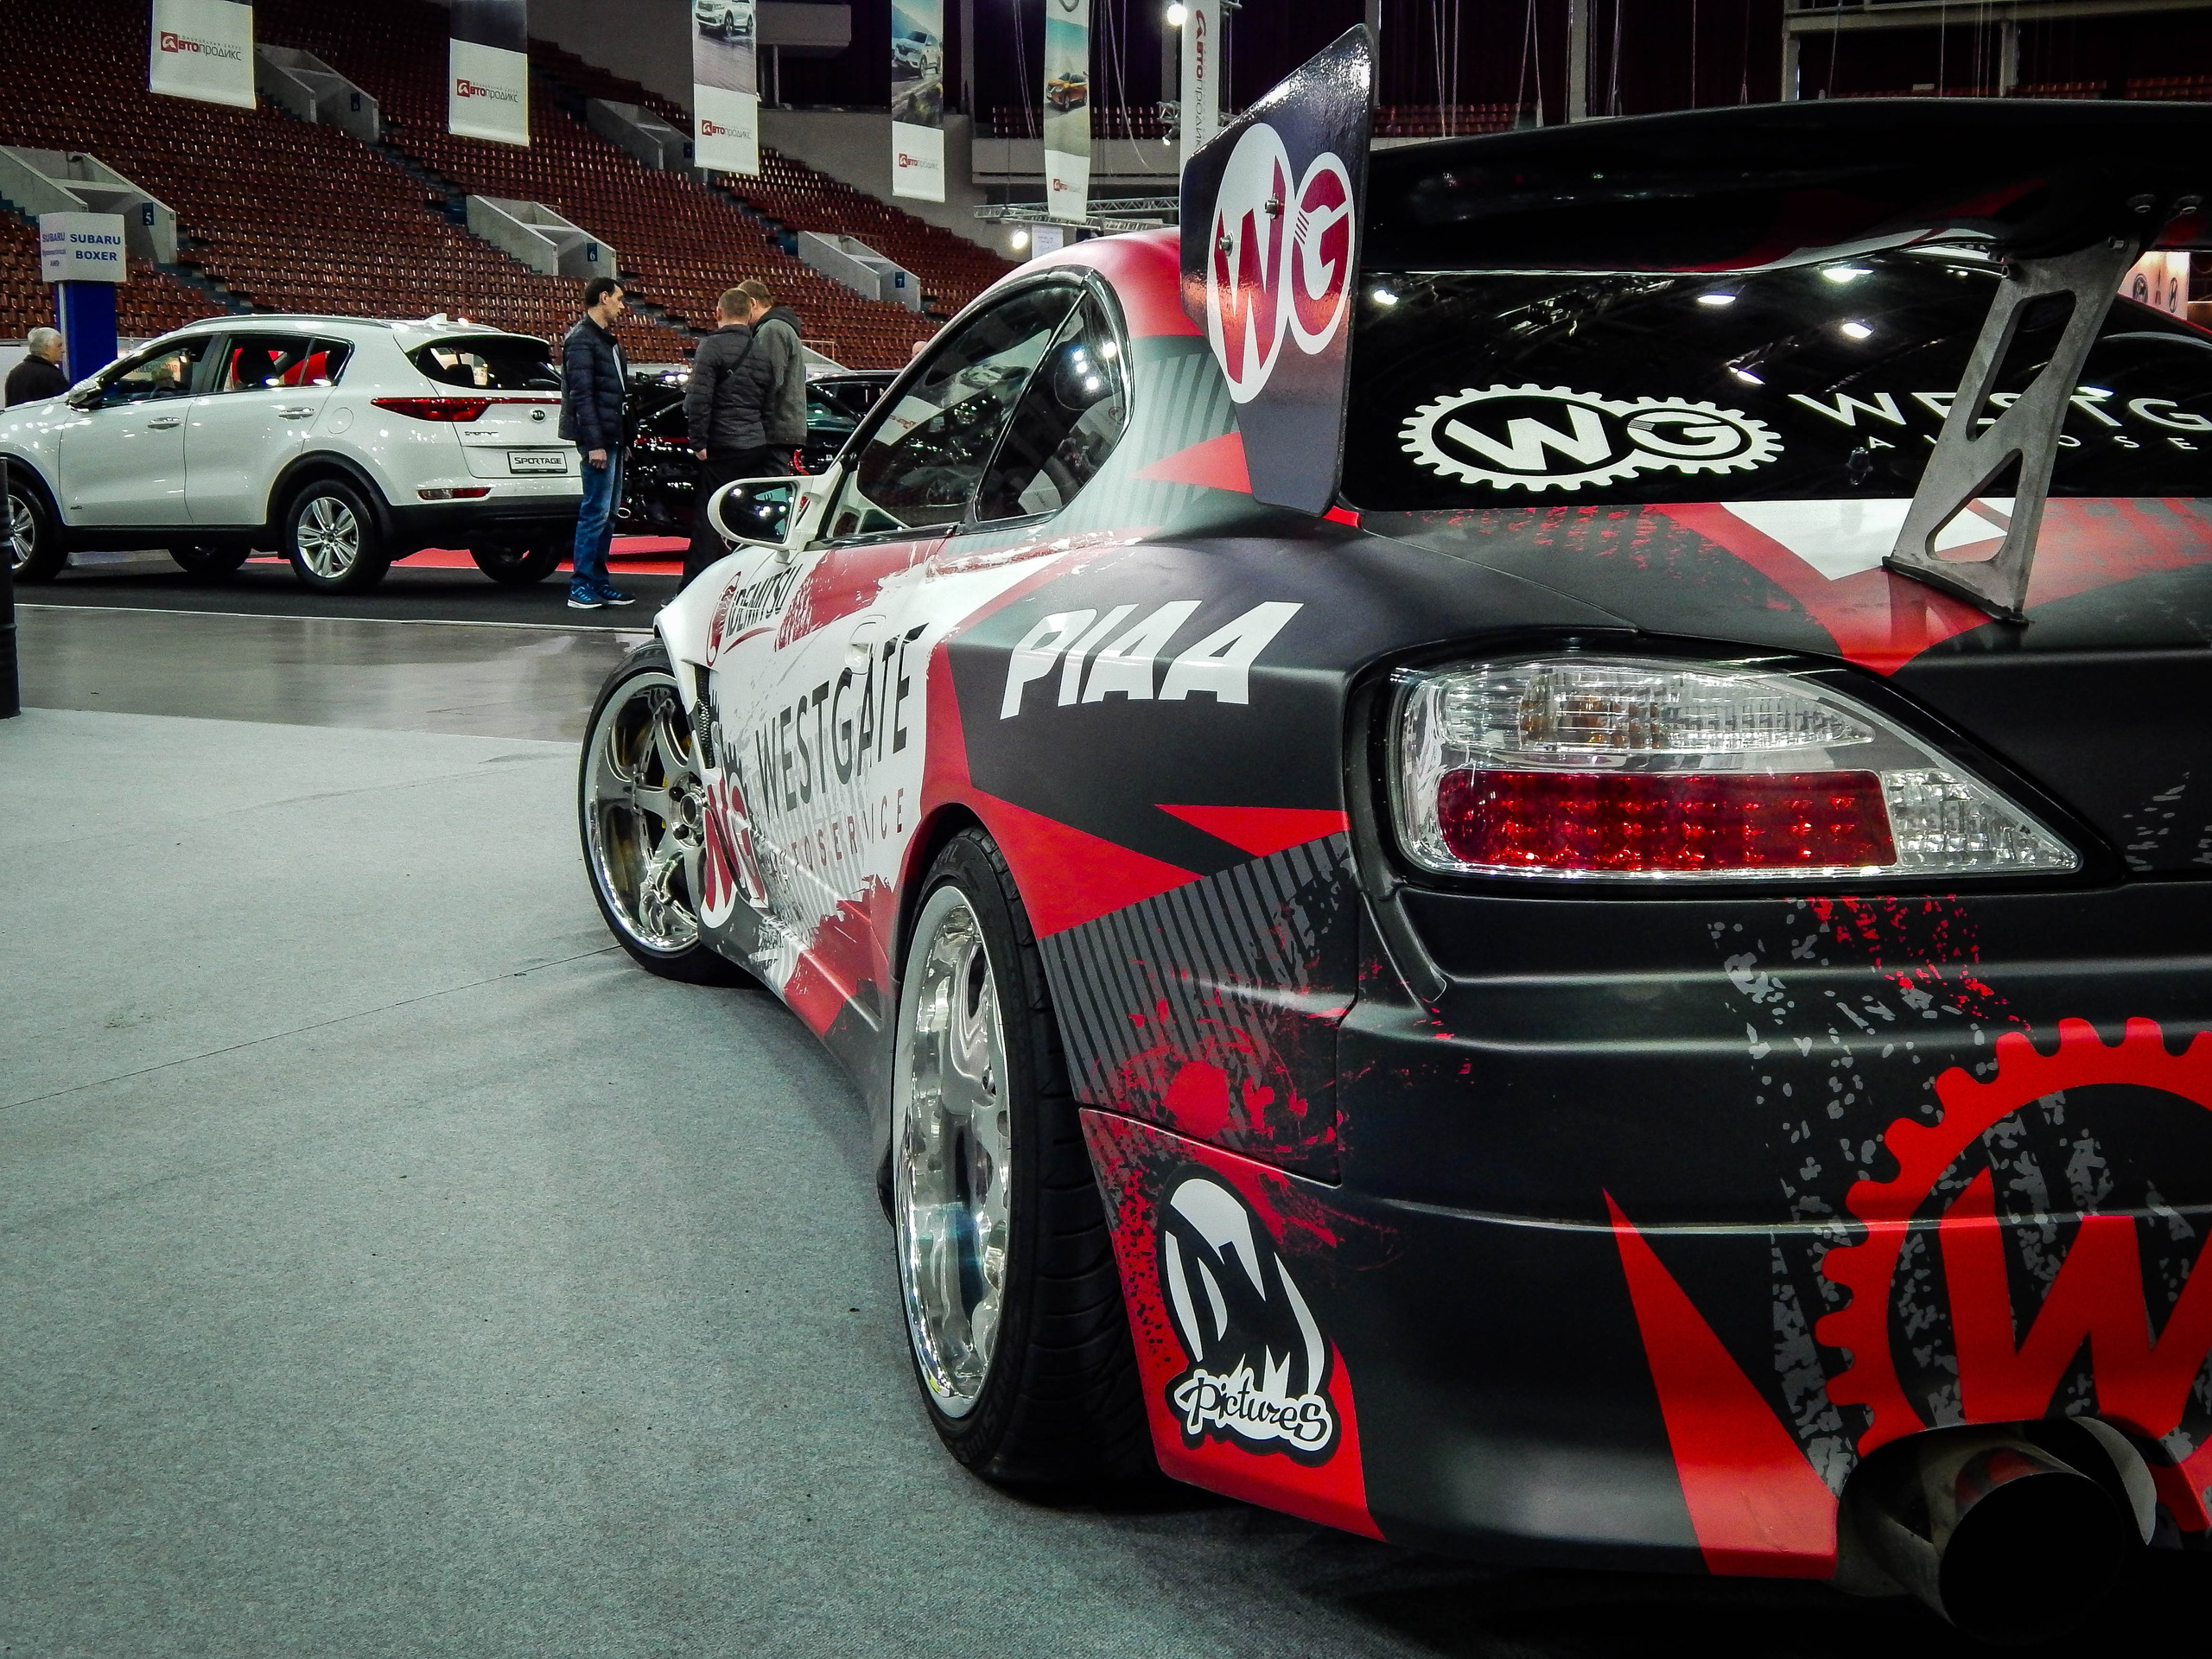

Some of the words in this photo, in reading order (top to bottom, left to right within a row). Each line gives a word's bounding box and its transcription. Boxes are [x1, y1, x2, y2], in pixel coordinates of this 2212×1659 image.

[145, 212, 152, 224] 5
[41, 232, 66, 243] SUBARU
[70, 233, 121, 245] SUBARU
[75, 250, 118, 262] BOXER
[589, 251, 595, 261] 6
[1214, 156, 1350, 384] WG
[897, 278, 903, 287] 7
[1445, 404, 1741, 471] WG
[514, 456, 563, 466] SPORTAGE
[725, 563, 804, 639] IDEMITSU
[1000, 600, 1305, 720] PIAA
[755, 622, 930, 822] WESTGATE
[1179, 1376, 1328, 1442] Pictures
